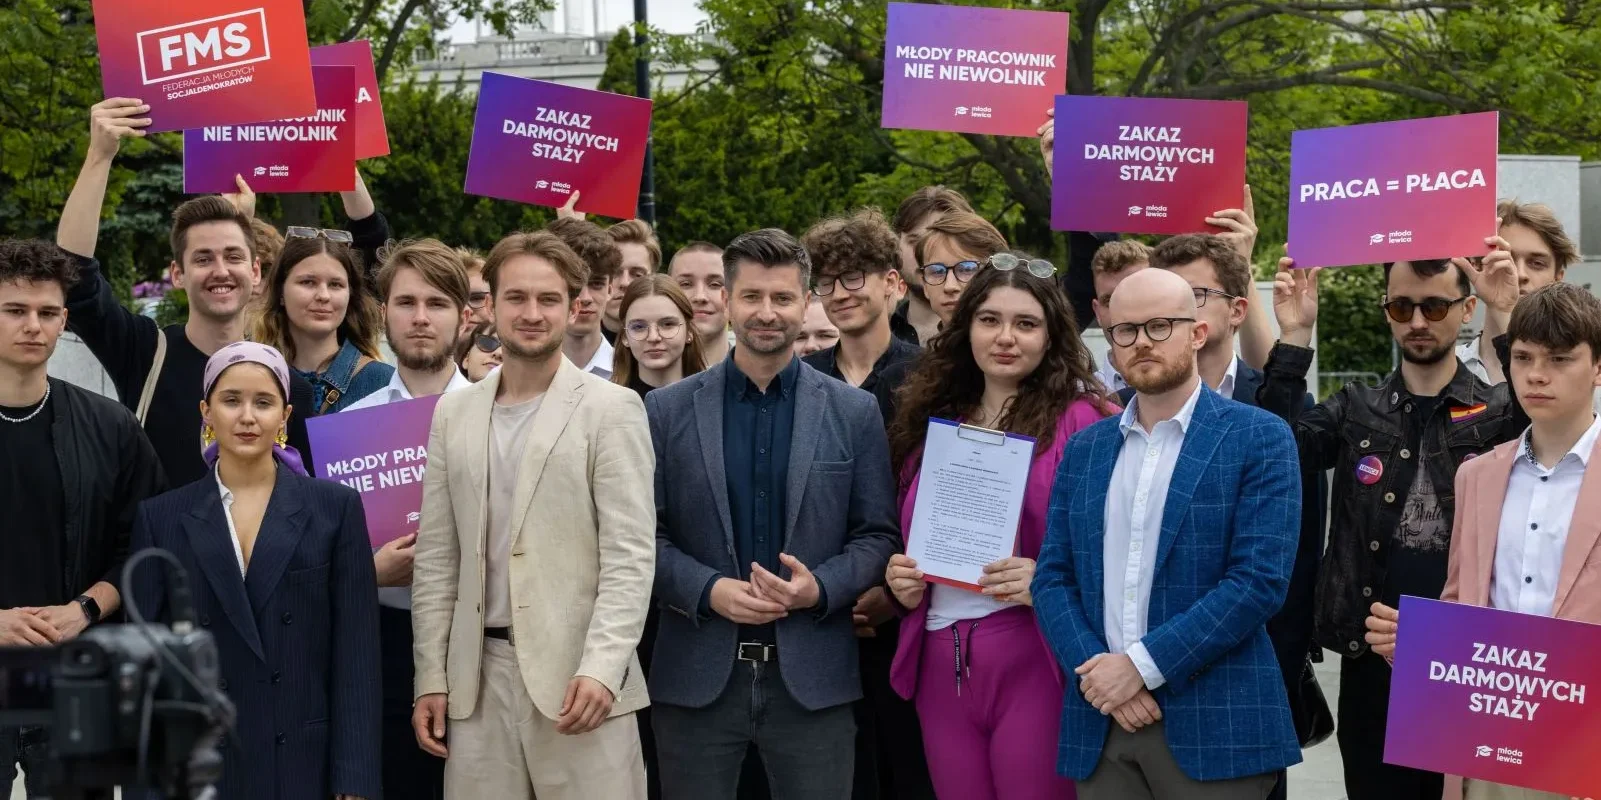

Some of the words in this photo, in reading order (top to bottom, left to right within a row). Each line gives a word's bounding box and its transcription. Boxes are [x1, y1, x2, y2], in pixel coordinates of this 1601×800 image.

[159, 22, 251, 71] FMS
[896, 45, 953, 61] MŁODY
[956, 49, 1056, 68] PRACOWNIK
[162, 76, 211, 92] FEDERACJA
[212, 66, 254, 81] MŁODYCH
[904, 63, 934, 79] NIE
[939, 65, 1046, 86] NIEWOLNIK
[167, 75, 253, 99] SOCJALDEMOKRATÓW
[535, 107, 592, 129] ZAKAZ
[203, 126, 232, 141] NIE
[237, 126, 337, 141] NIEWOLNIK
[503, 120, 619, 152] DARMOWYCH
[1119, 126, 1181, 142] ZAKAZ
[532, 143, 584, 163] STAŻY
[1084, 145, 1214, 164] DARMOWYCH
[1120, 162, 1178, 182] STAŻY
[1300, 178, 1380, 202] PRACA
[1387, 180, 1399, 190] =
[1406, 169, 1486, 193] PŁACA
[1389, 236, 1412, 244] lewica
[327, 452, 388, 477] MŁODY
[1472, 642, 1548, 672] ZAKAZ
[1429, 661, 1586, 704] DARMOWYCH
[1469, 692, 1540, 721] STAŻY
[1496, 754, 1522, 764] lewica
[1497, 747, 1523, 757] młoda
